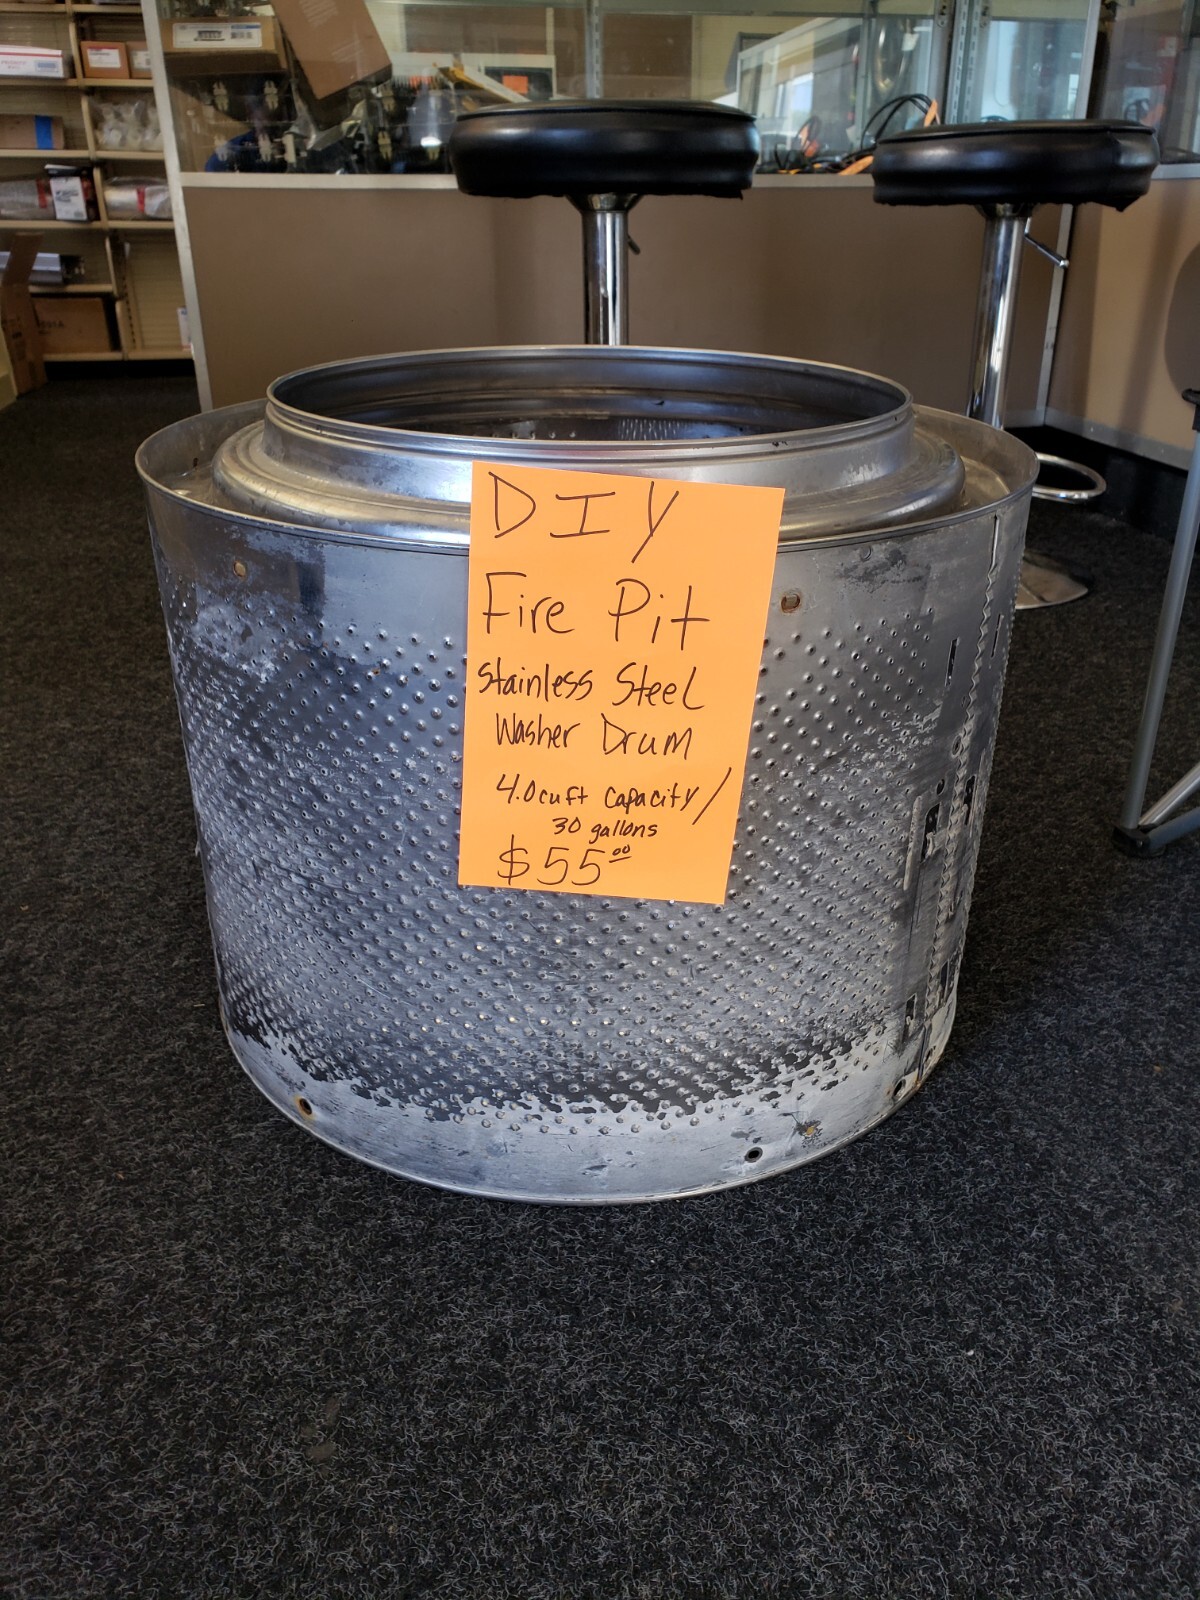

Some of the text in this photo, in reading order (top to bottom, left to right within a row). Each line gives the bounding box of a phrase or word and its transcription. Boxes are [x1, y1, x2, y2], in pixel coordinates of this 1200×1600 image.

[489, 472, 680, 564] DIY
[482, 572, 710, 651] Fire Pit
[612, 662, 705, 711] Steel
[496, 713, 692, 760] Washer Drum
[552, 814, 659, 841] 30 gallons
